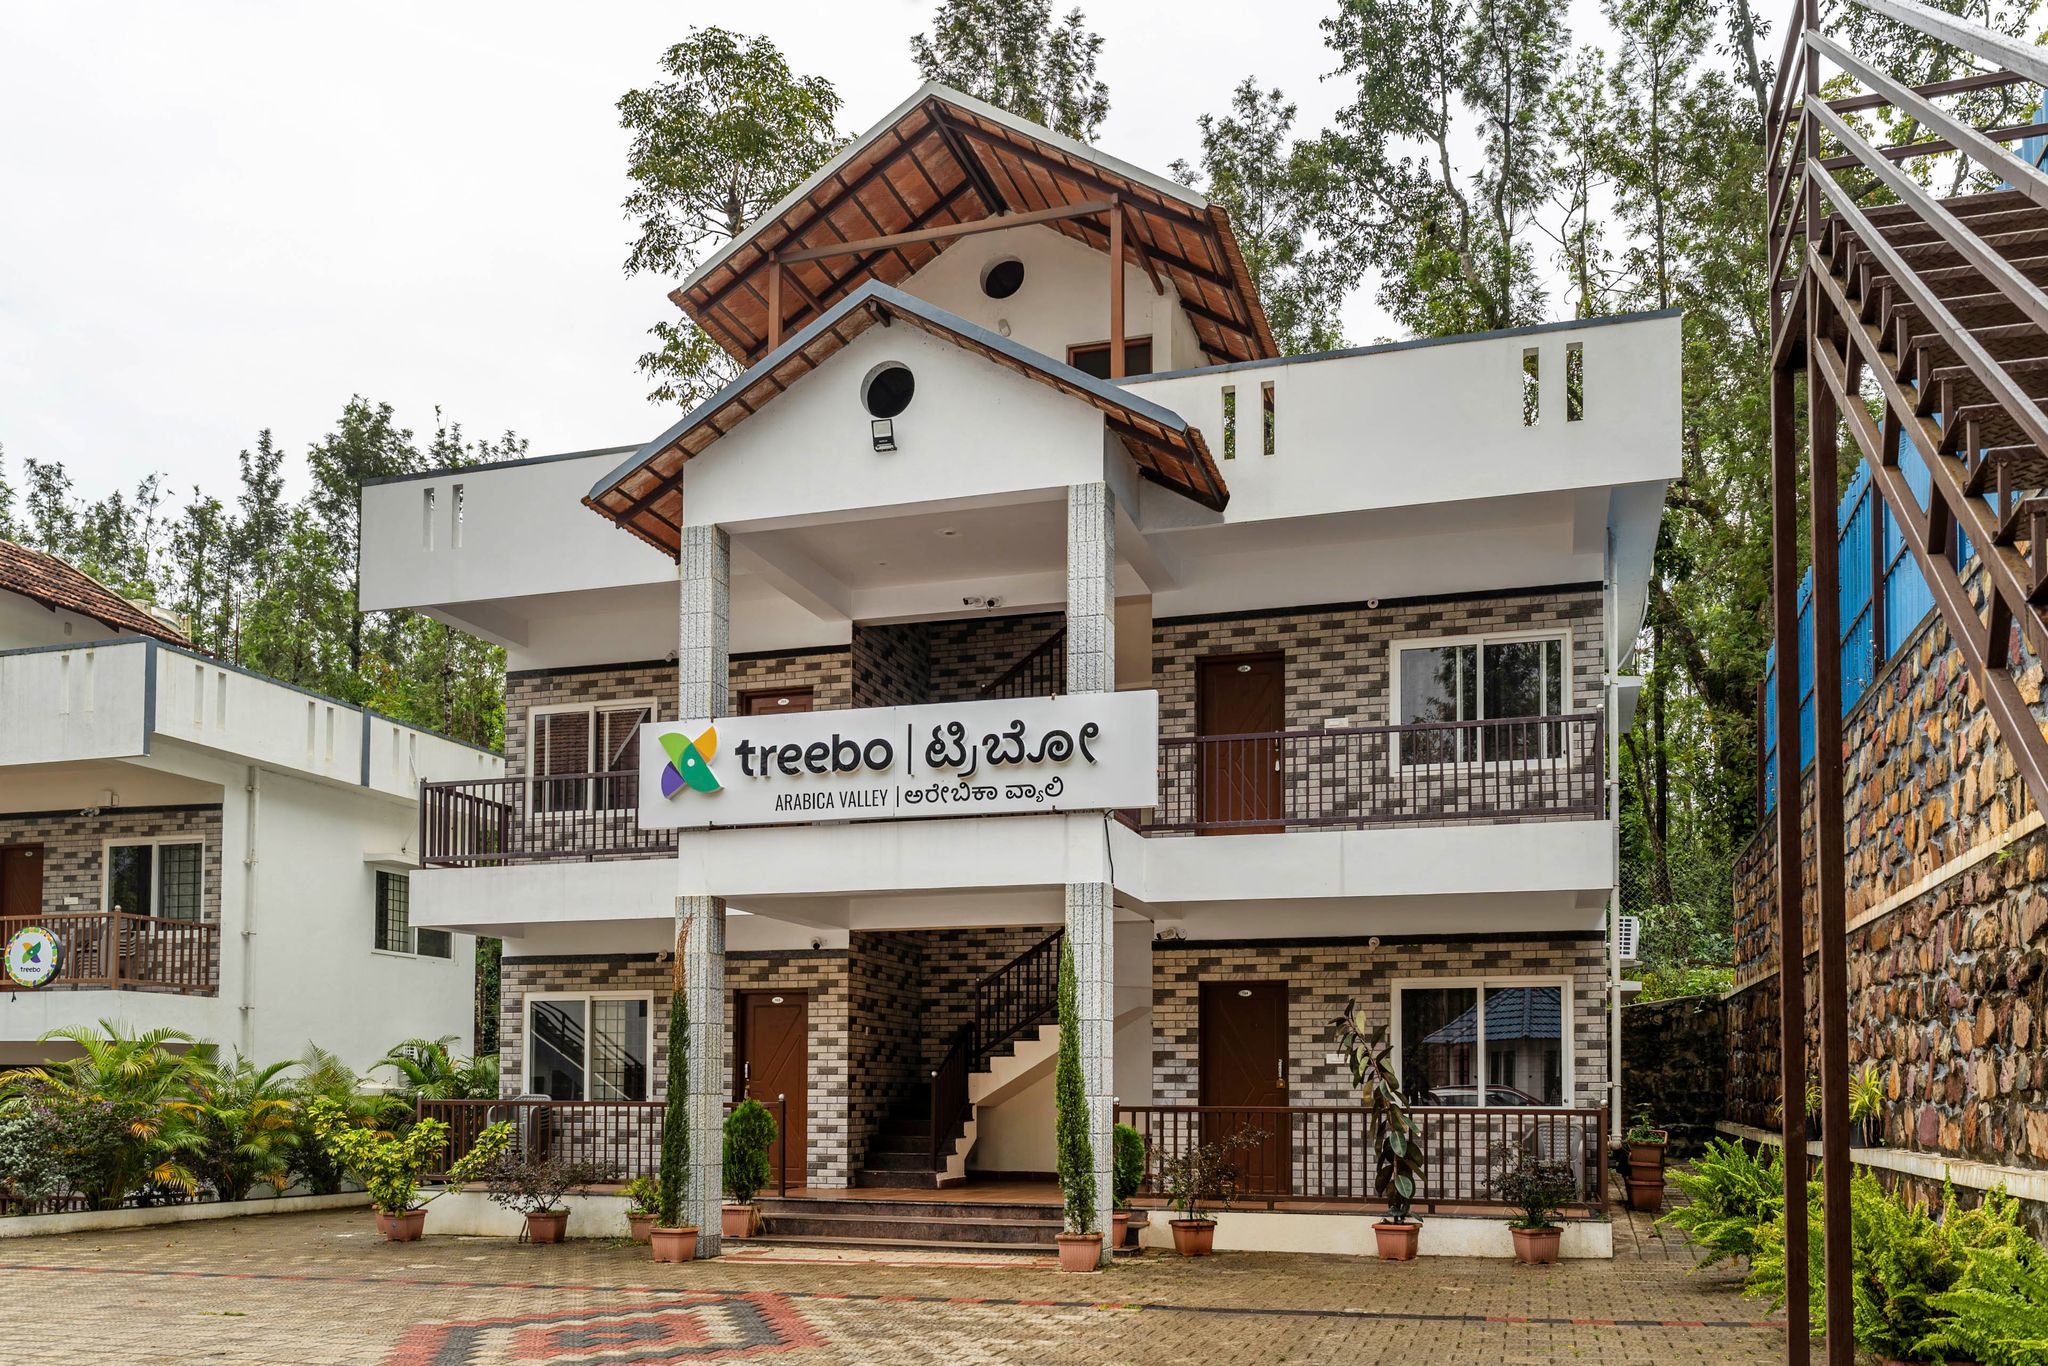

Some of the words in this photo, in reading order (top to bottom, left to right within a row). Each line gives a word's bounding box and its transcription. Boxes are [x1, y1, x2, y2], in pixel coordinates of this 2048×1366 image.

[735, 734, 893, 777] treebo
[925, 719, 1099, 777] ಟ್ರಿಬೋ
[775, 791, 835, 811] ARABICA
[839, 789, 888, 808] VALLEY
[904, 781, 998, 804] ಅರೇಬಿಕಾ
[1005, 776, 1064, 802] ವ್ಯಾಲಿ
